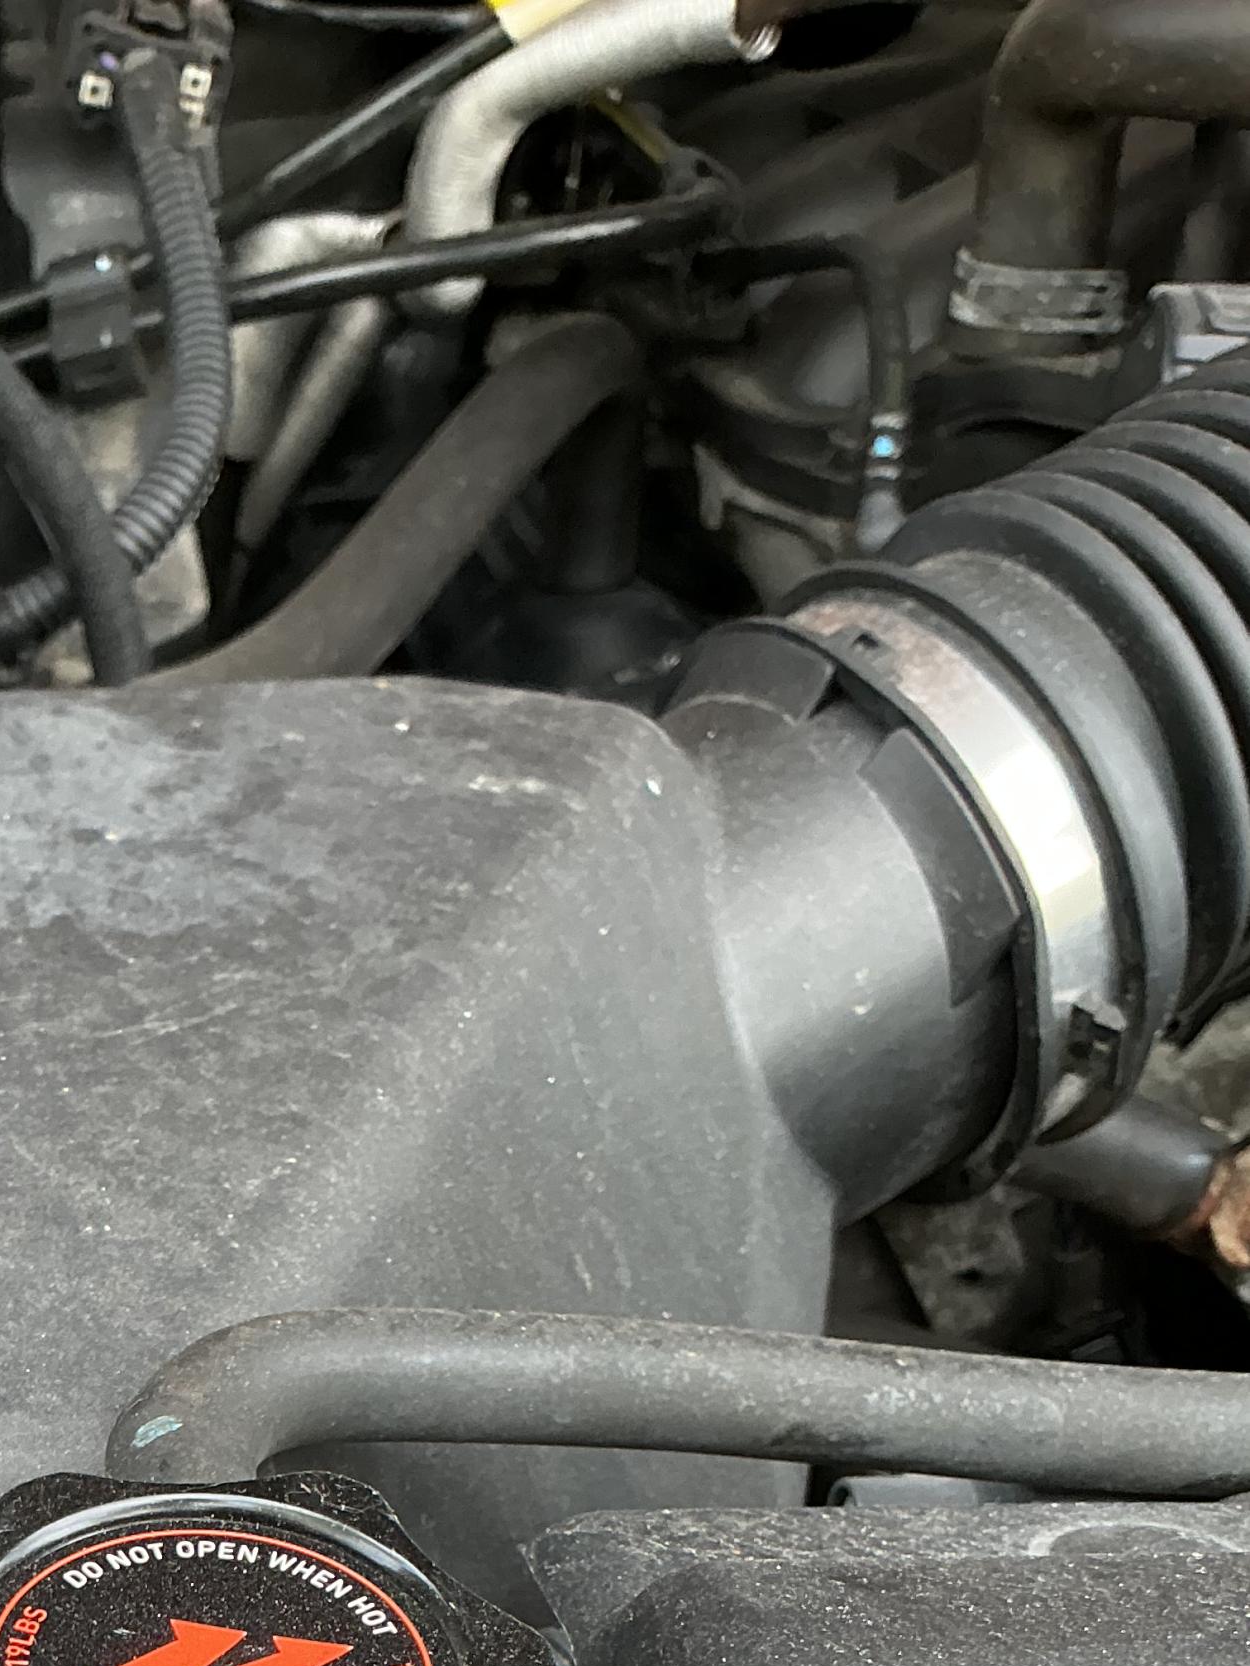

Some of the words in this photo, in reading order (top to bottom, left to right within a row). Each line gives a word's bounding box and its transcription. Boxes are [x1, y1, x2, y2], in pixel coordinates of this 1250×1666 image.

[61, 1561, 105, 1590] DO
[105, 1541, 165, 1570] NOT
[174, 1539, 260, 1565] OPEN
[267, 1550, 354, 1600] WHEN
[346, 1594, 400, 1637] HOT
